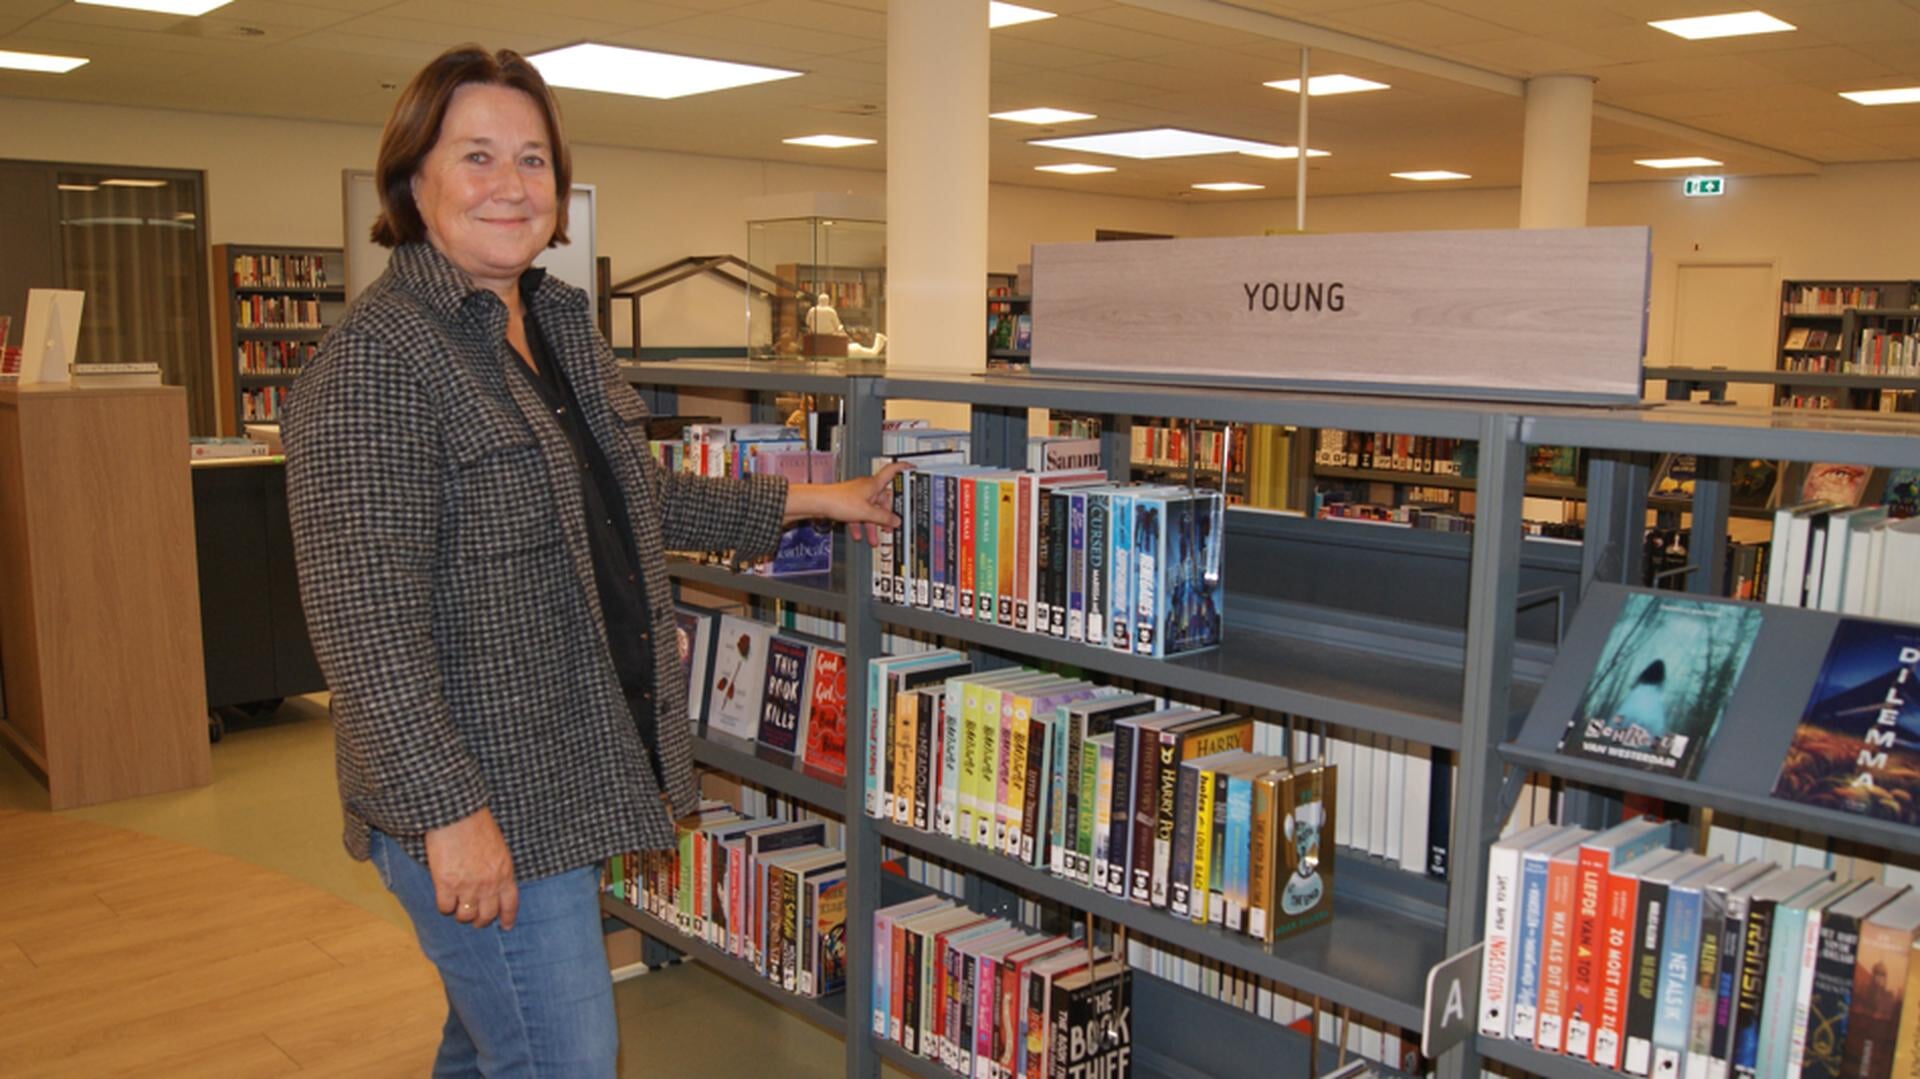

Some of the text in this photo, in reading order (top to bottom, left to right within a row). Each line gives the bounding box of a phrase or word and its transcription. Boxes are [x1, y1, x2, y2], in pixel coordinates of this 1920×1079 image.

[1244, 282, 1345, 311] YOUNG
[1090, 506, 1103, 567] CURSED
[774, 653, 799, 677] THIS
[818, 653, 838, 673] Good
[768, 675, 799, 704] BOOK
[764, 702, 795, 730] KILLS
[1850, 646, 1920, 790] DILEMMA
[1196, 730, 1245, 758] HARRY
[917, 738, 927, 801] MEADOW
[1159, 769, 1176, 840] HARRY PO
[1581, 871, 1598, 916] LIEFDE
[1553, 911, 1566, 936] WAT
[1580, 919, 1593, 944] VAN
[1610, 928, 1624, 946] ZO
[1550, 939, 1565, 963] ALS
[1577, 946, 1592, 958] A
[1740, 910, 1770, 1015] TRANSIT
[1548, 965, 1563, 987] DIT
[1577, 960, 1591, 984] TOT
[1606, 949, 1622, 985] MOET
[1668, 952, 1688, 982] NET
[1441, 979, 1464, 1028] A
[1545, 989, 1560, 1013] HET
[1603, 987, 1618, 1011] HET
[1665, 980, 1686, 1005] ALS
[1070, 1006, 1130, 1062] BOOK
